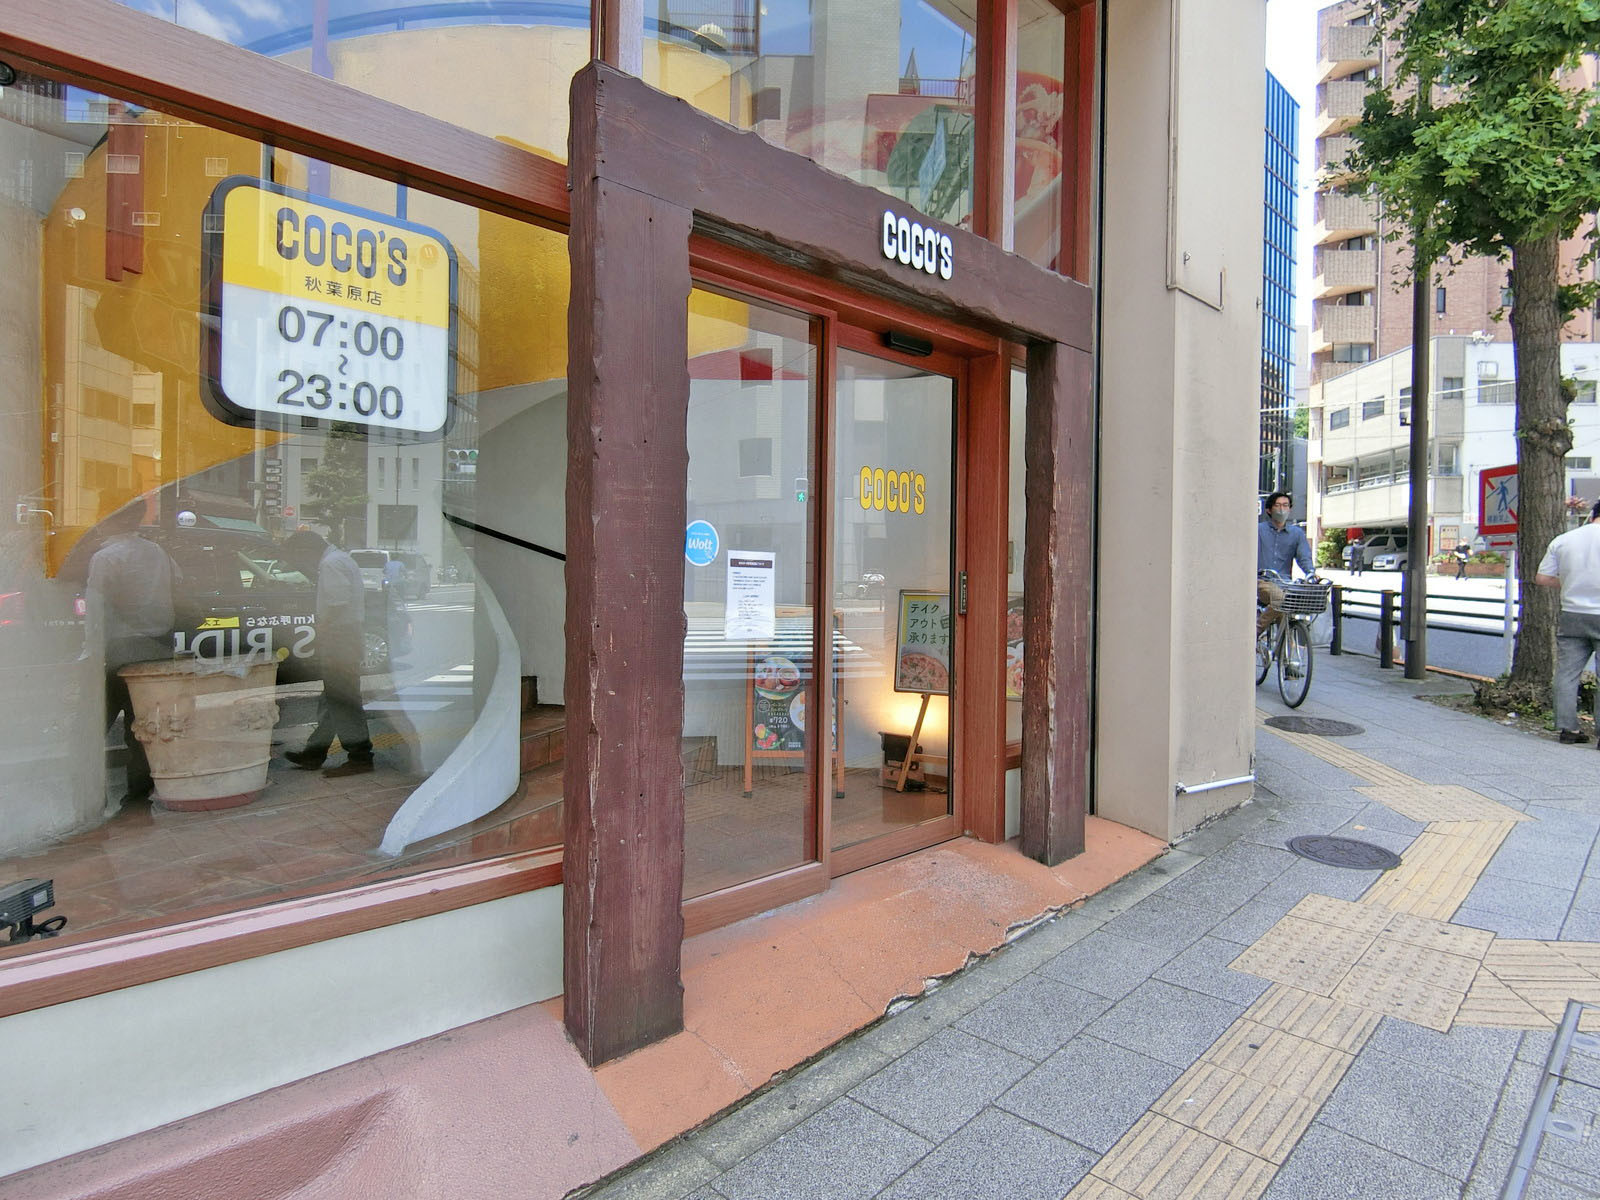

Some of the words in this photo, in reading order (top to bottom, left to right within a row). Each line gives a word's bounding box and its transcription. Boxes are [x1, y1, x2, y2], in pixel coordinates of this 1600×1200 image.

[277, 207, 407, 286] COCO'S
[883, 210, 952, 280] COCO'S
[305, 276, 382, 306] 秋葉原店
[278, 306, 404, 361] 07:00
[277, 369, 403, 419] 23:00
[860, 465, 926, 515] COCO'S
[688, 538, 713, 550] Wolt
[910, 603, 939, 614] テイク
[910, 618, 938, 629] アウト
[908, 631, 949, 645] 承ります
